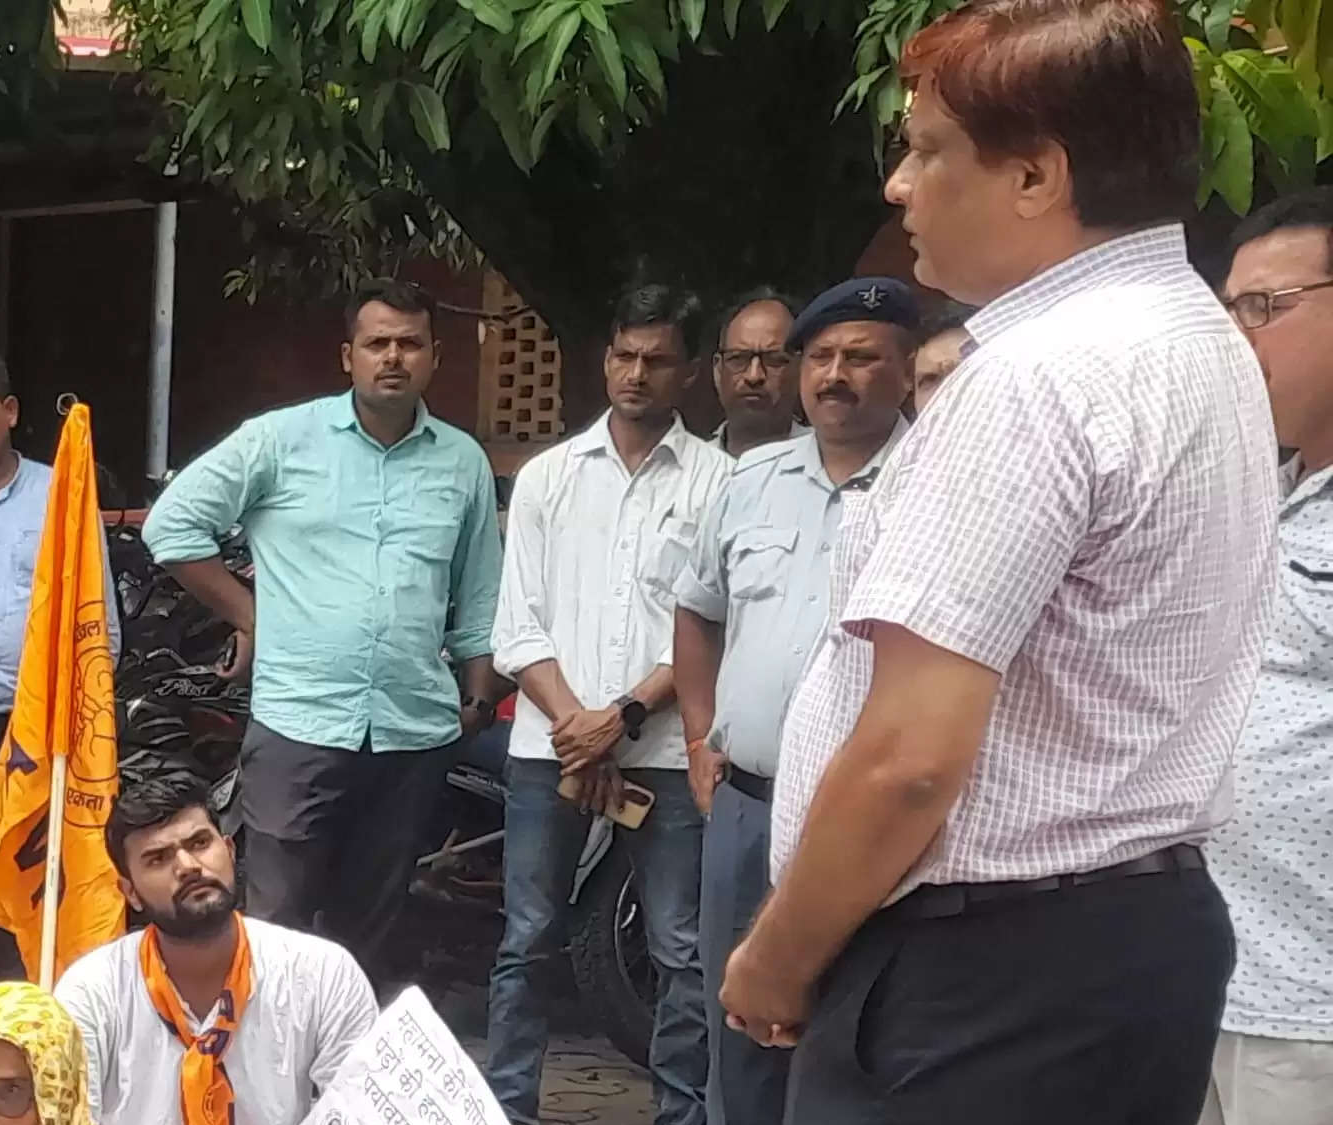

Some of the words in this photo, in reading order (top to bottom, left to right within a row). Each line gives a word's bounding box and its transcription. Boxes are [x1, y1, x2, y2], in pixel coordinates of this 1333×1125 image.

[66, 788, 105, 812] एकता
[397, 1009, 446, 1074] महामना
[398, 1067, 423, 1100] की
